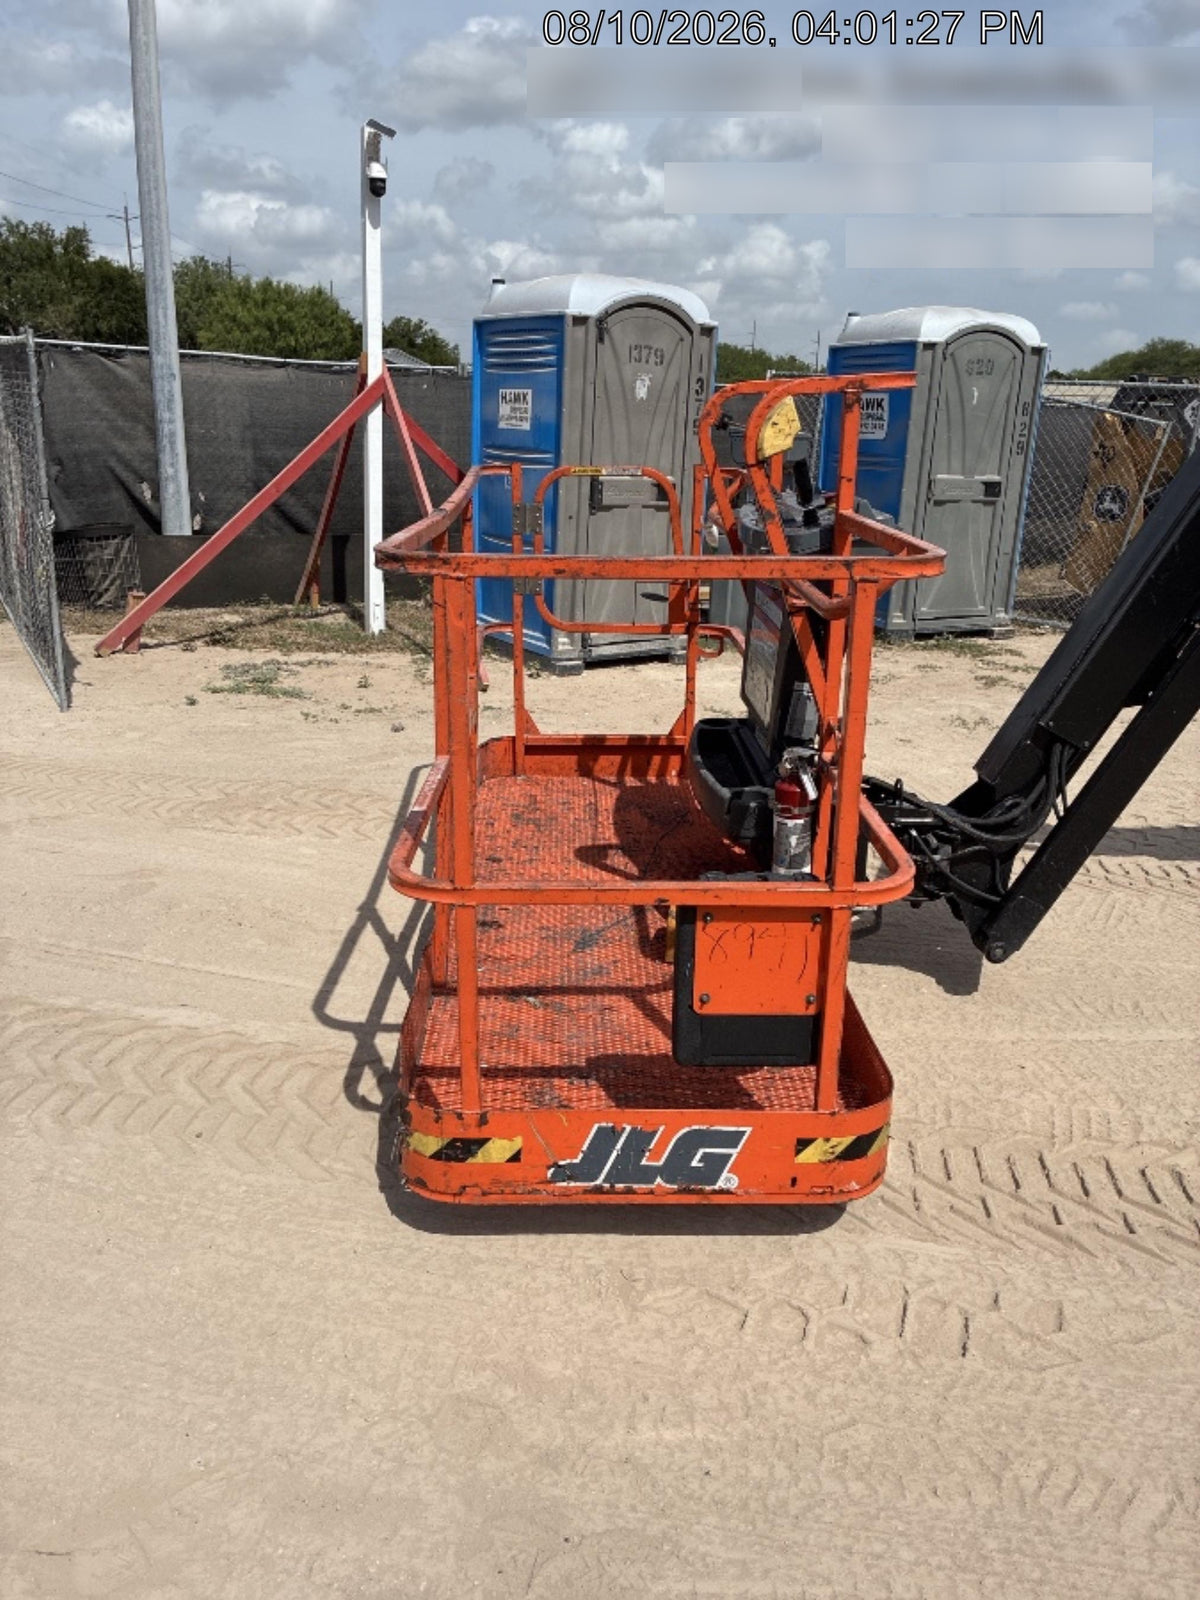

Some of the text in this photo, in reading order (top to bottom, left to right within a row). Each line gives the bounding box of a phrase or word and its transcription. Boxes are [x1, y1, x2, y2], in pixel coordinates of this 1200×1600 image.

[628, 344, 665, 366] 1379
[501, 391, 529, 406] HAWK
[860, 397, 885, 411] AWK
[547, 1122, 753, 1188] JLG
